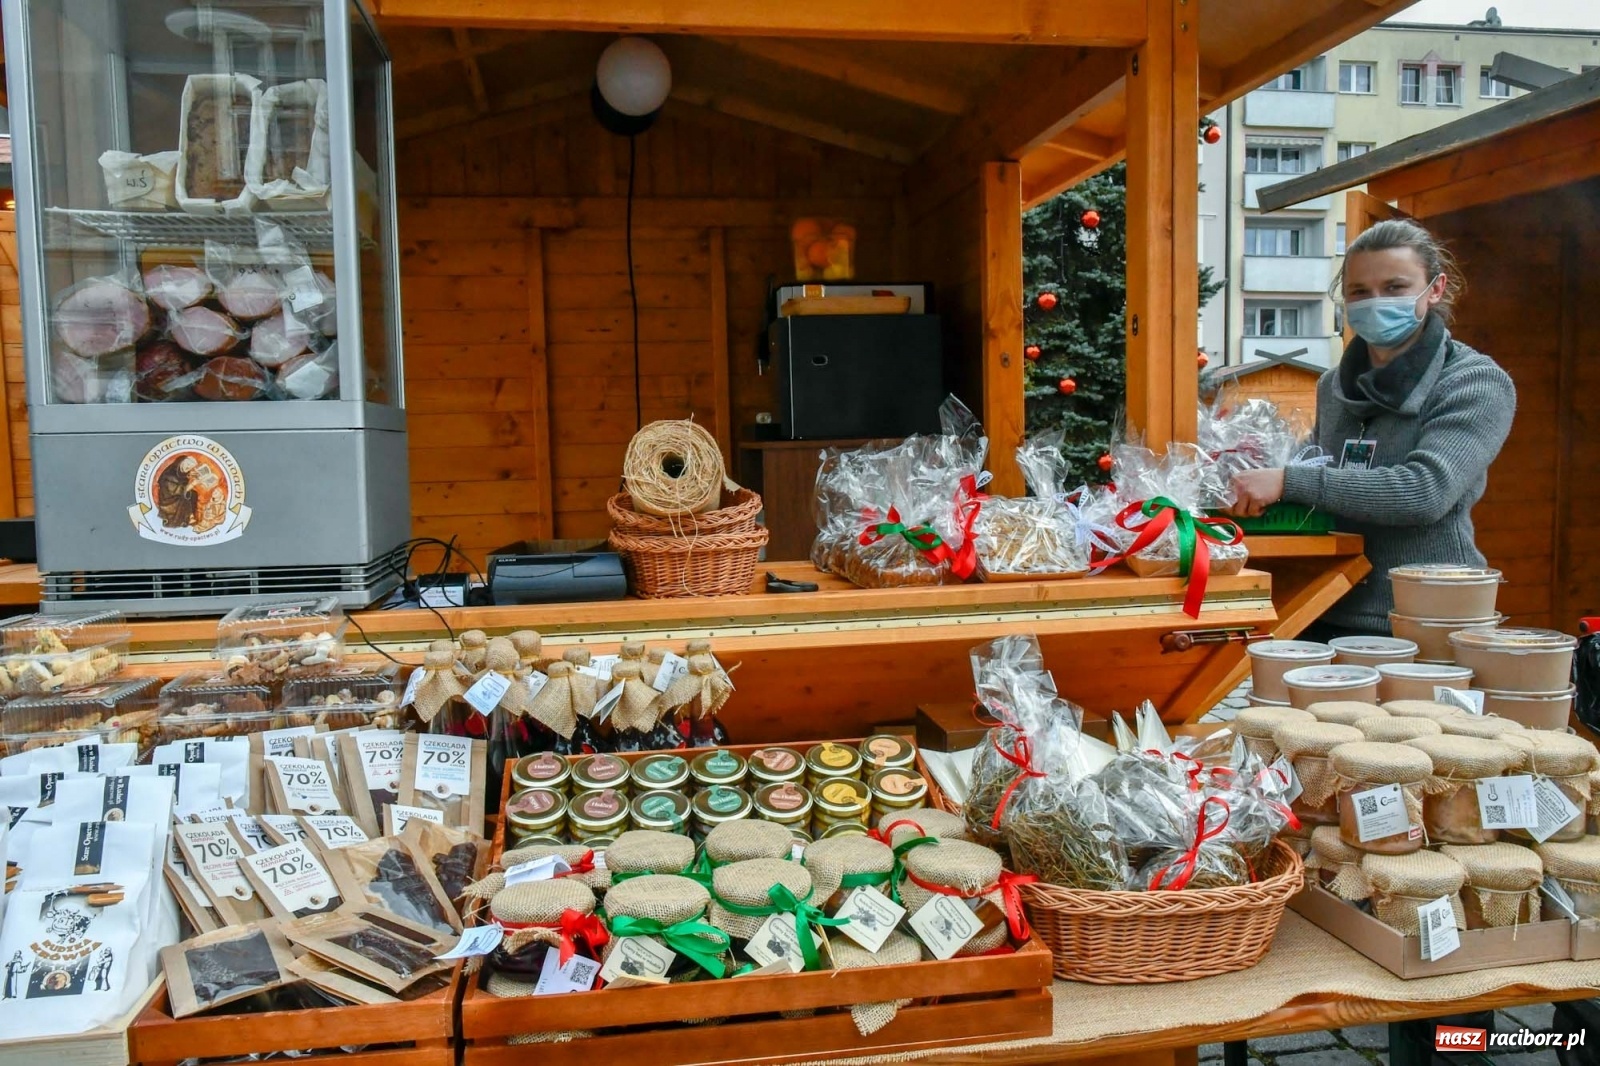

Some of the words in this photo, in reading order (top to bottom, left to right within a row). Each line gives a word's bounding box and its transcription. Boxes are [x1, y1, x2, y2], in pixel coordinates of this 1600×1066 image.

[423, 740, 467, 750] CZEKOLADA
[422, 750, 466, 766] 70%
[279, 763, 322, 771] CZEKOLADA
[282, 771, 326, 786] 70%
[185, 830, 226, 839] CZEKOLADA
[318, 825, 362, 840] 70%
[192, 837, 238, 864] 70%
[255, 846, 302, 866] CZEKOLADA
[262, 854, 314, 884] 70%
[29, 941, 103, 962] KRÓWKA
[41, 939, 93, 953] RUDZKA
